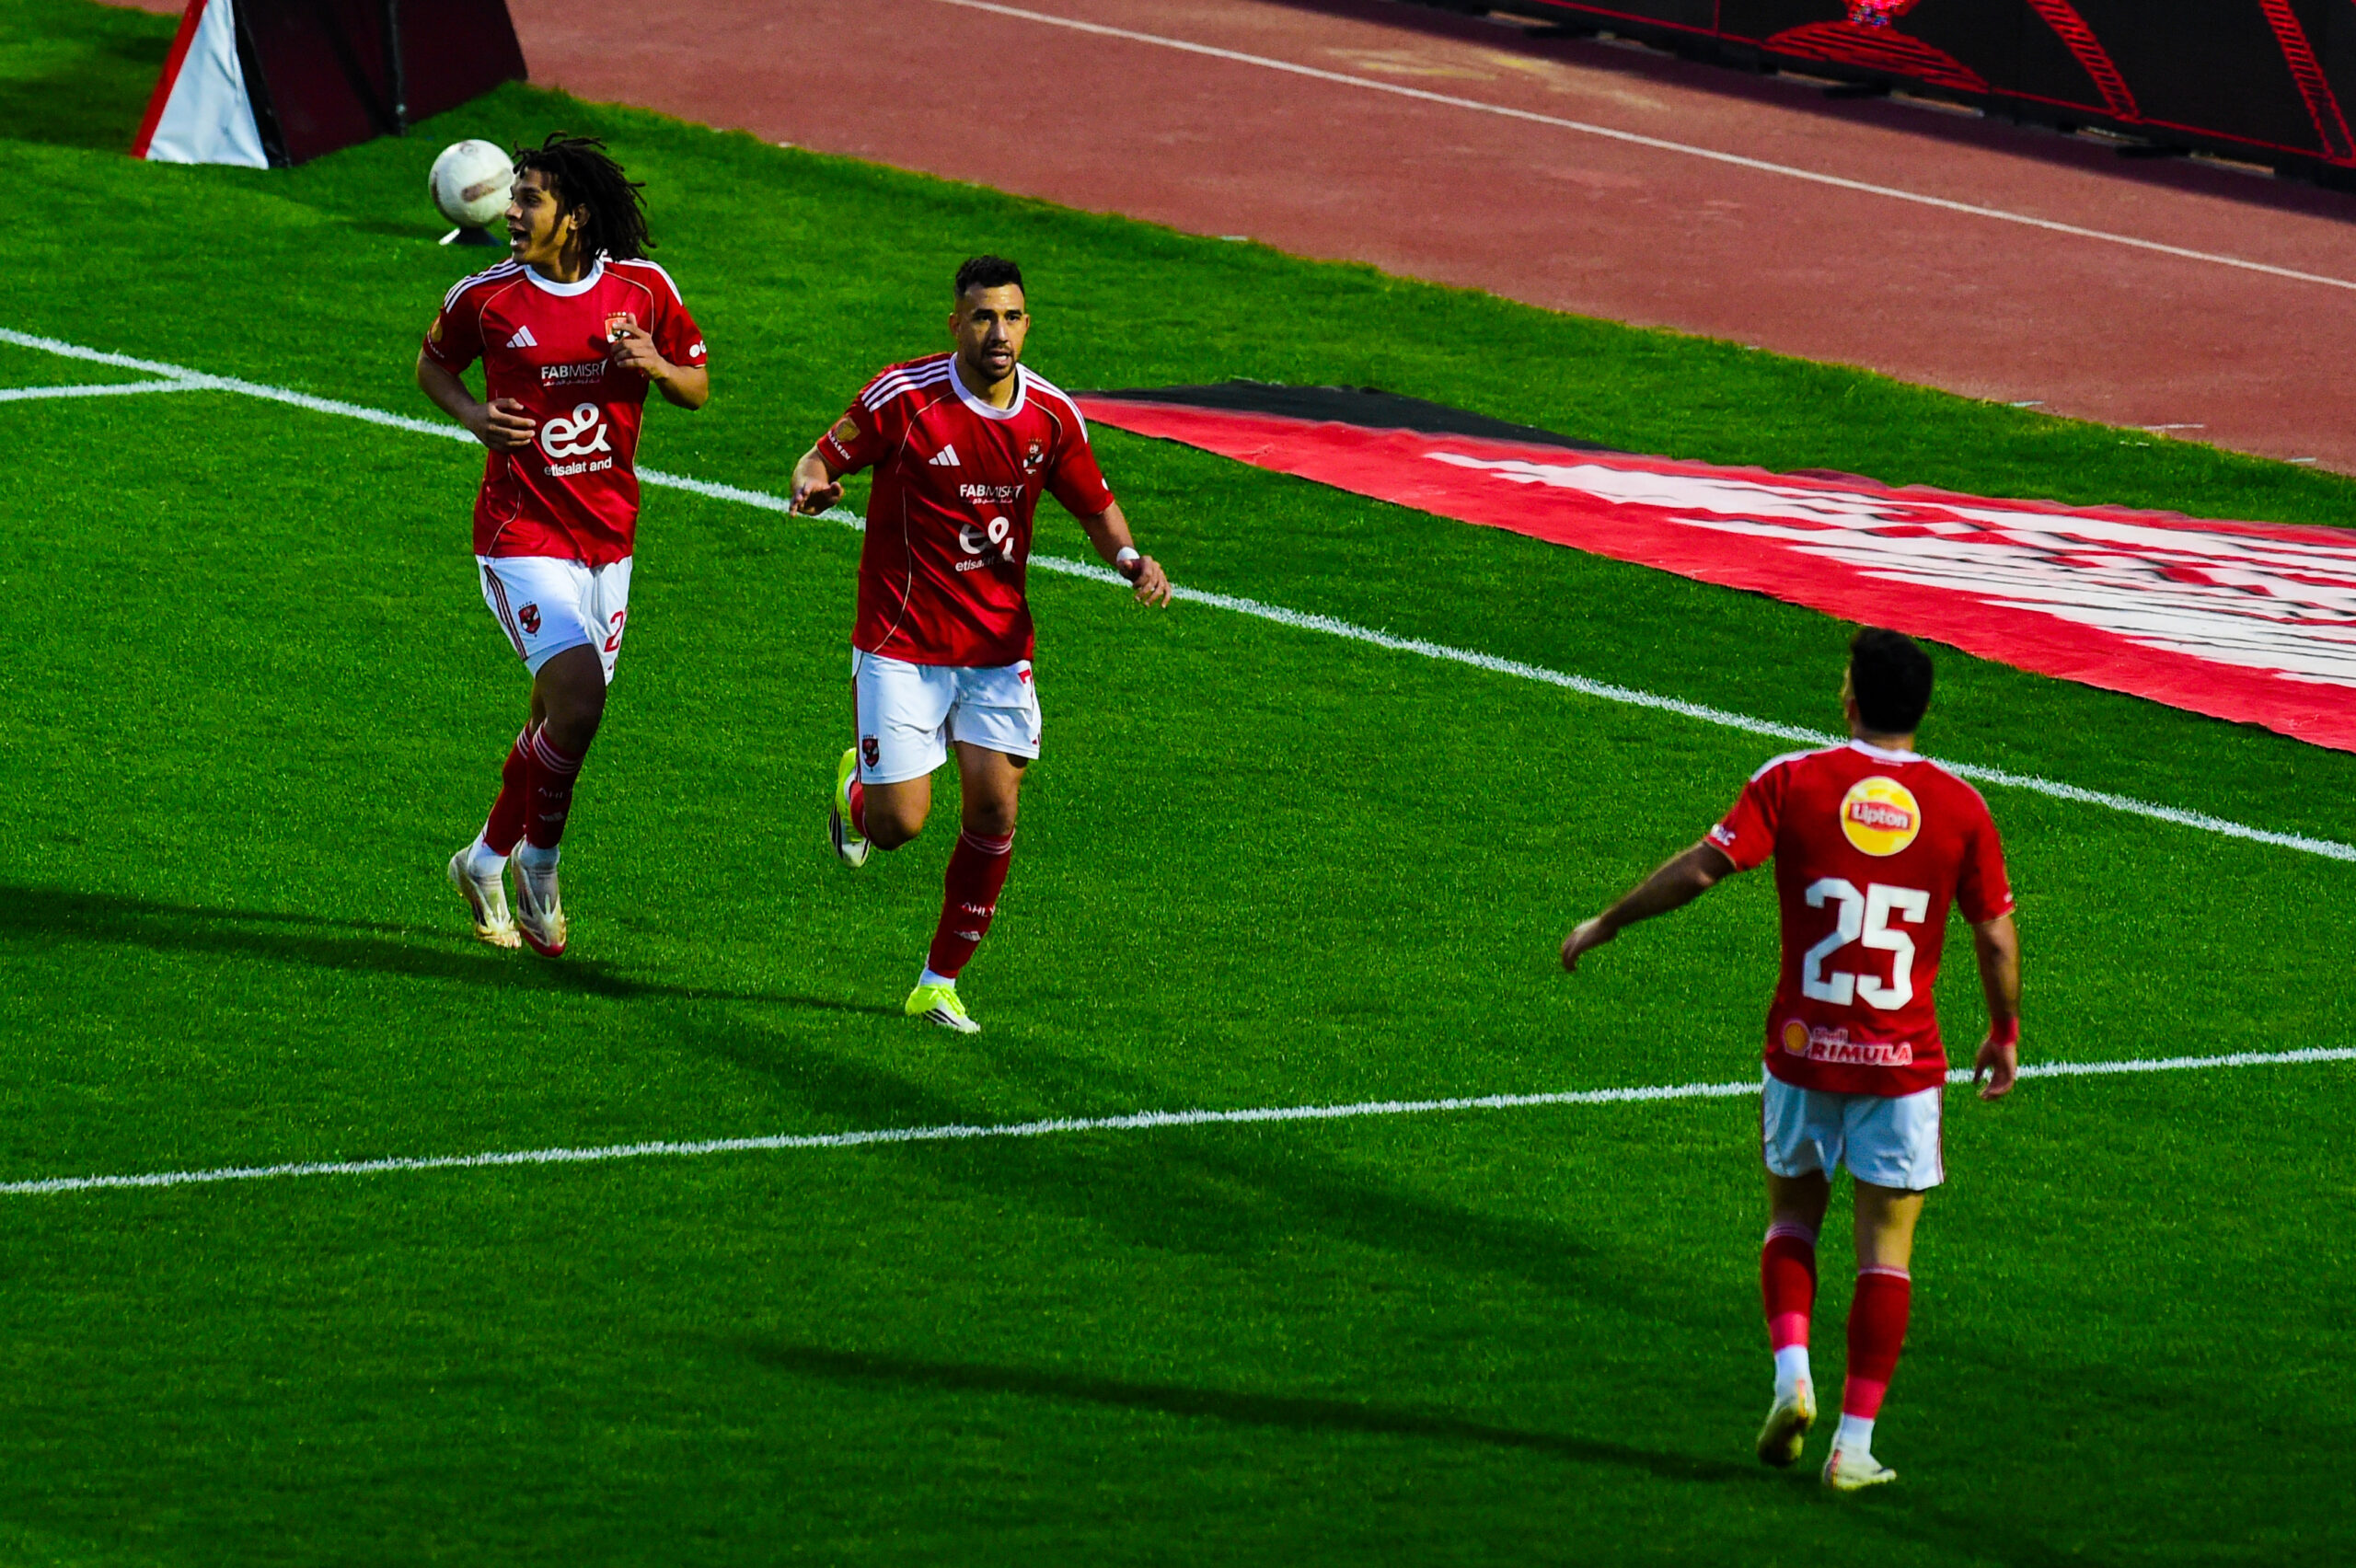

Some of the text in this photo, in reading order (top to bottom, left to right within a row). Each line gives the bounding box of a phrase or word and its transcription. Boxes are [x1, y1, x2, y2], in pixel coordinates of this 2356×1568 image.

[544, 456, 612, 477] etisalat and
[1852, 803, 1909, 829] Lipton
[1802, 877, 1930, 1010] 25
[1809, 1042, 1912, 1065] RIMULA
